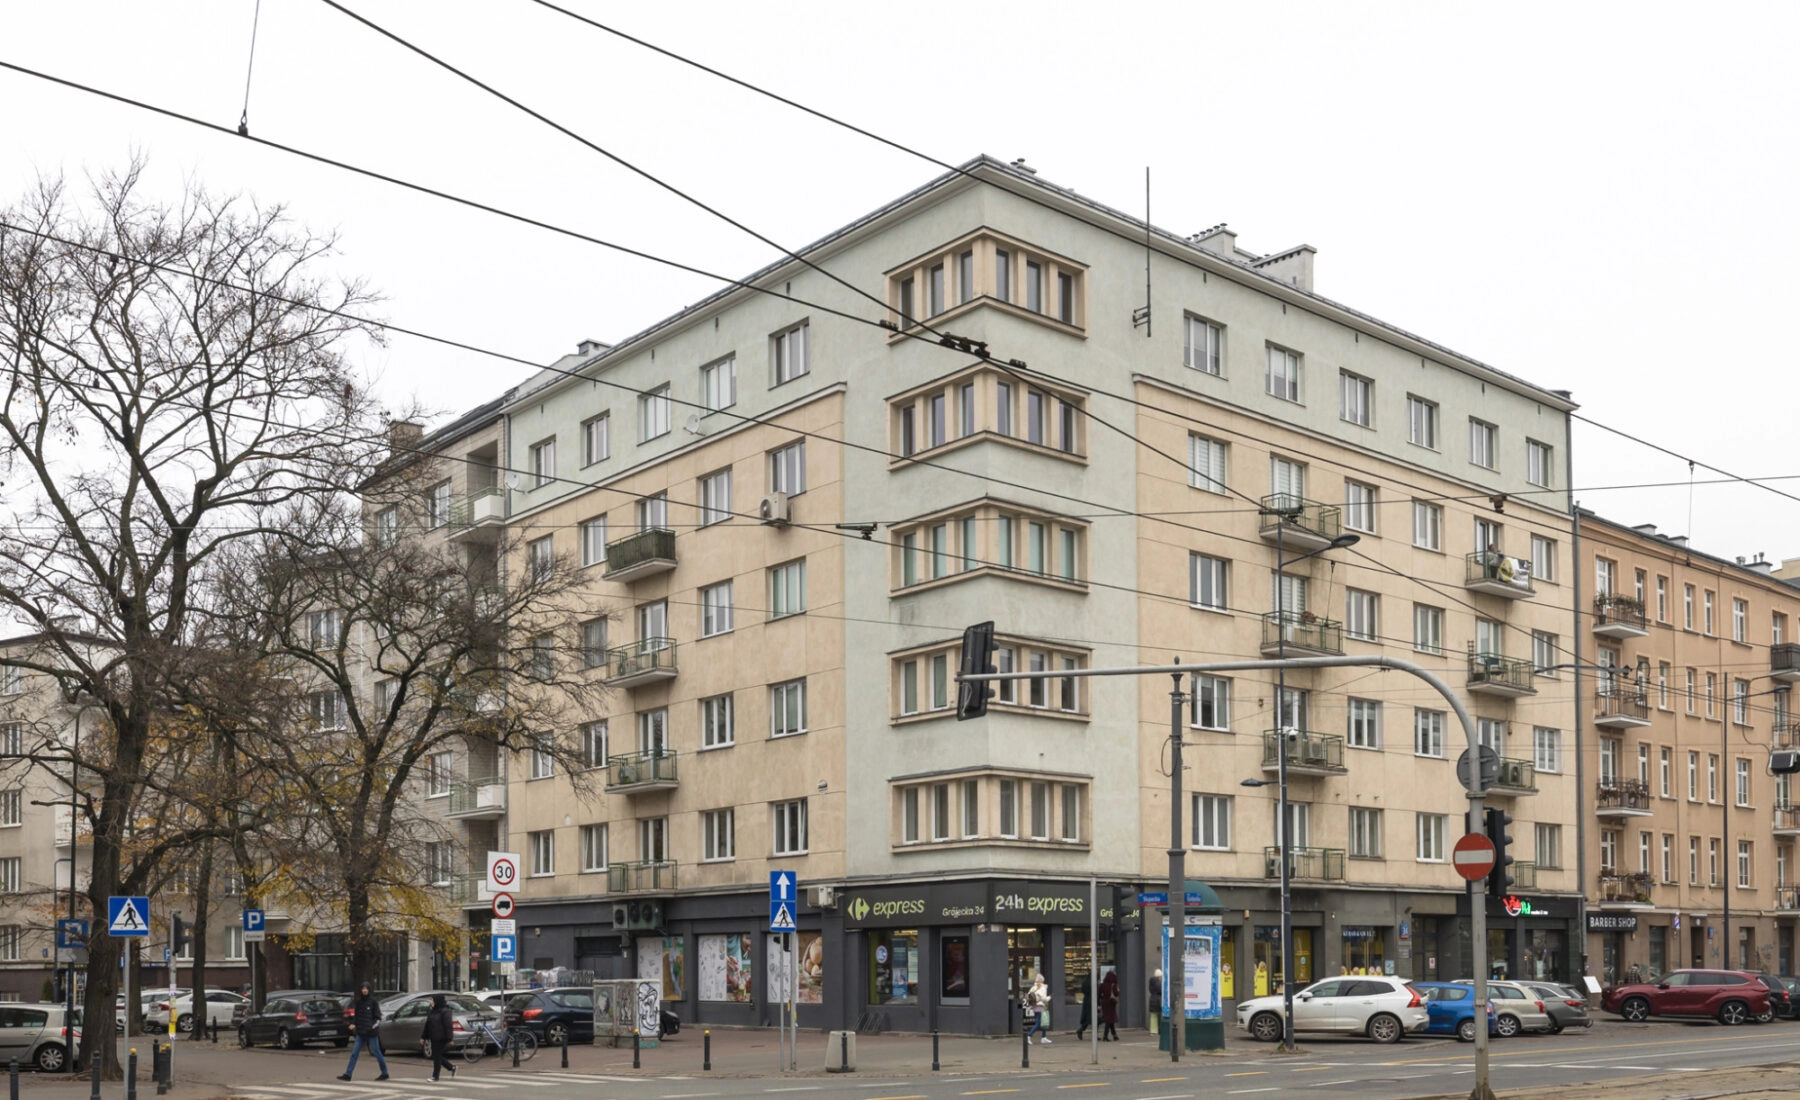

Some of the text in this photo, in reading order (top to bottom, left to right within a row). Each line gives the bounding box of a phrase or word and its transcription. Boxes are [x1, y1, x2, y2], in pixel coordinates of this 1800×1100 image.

[496, 866, 513, 879] 30
[873, 899, 925, 919] express
[942, 906, 985, 918] Grójecka 34
[995, 894, 1024, 912] 24h
[1027, 896, 1084, 915] express
[248, 911, 260, 929] P
[1589, 917, 1637, 928] BARBER SHOP
[497, 937, 512, 959] P
